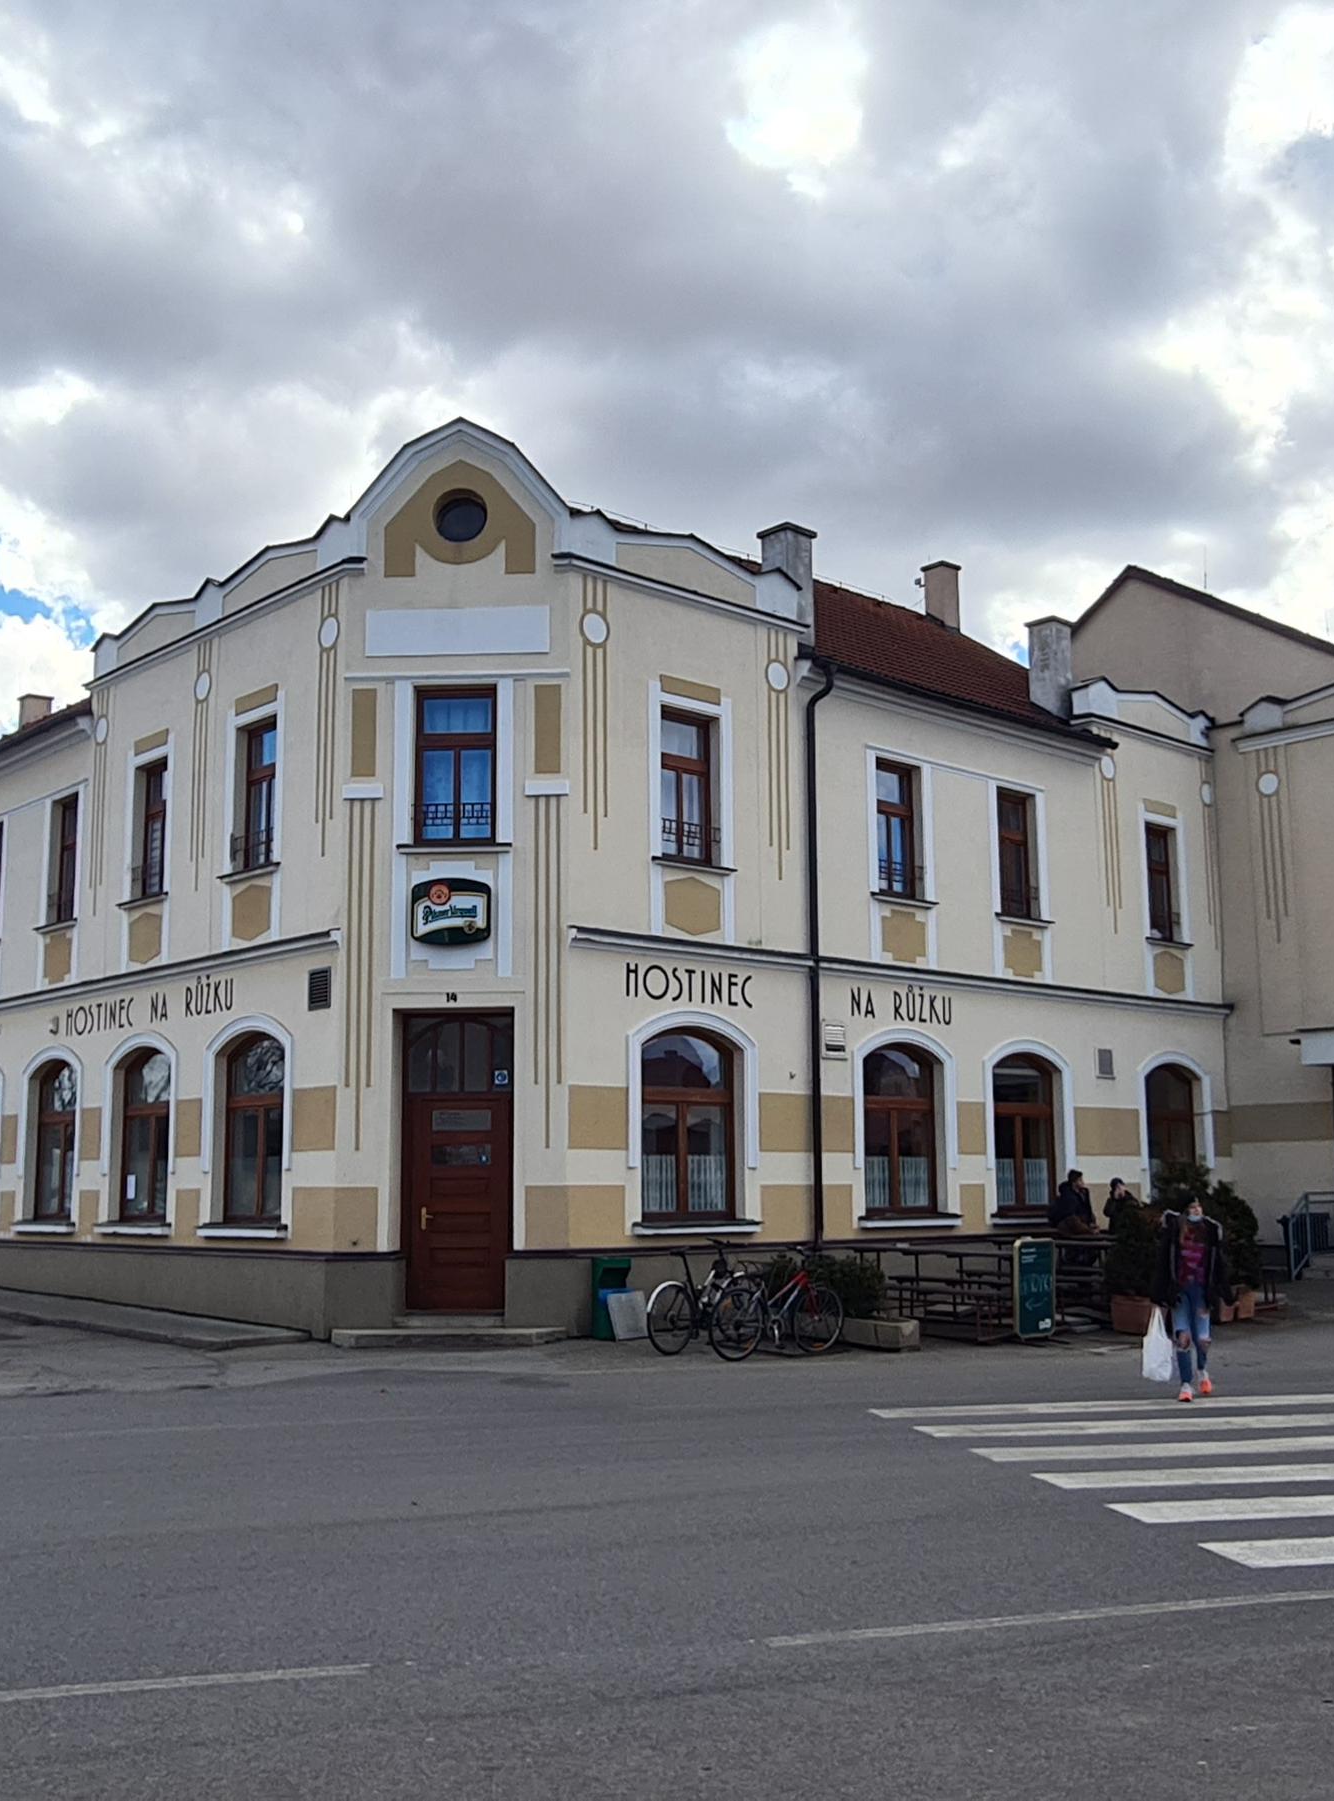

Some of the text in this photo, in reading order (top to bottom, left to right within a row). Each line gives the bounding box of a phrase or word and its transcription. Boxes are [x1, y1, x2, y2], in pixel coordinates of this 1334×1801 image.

[65, 975, 234, 1037] HOSTINEC NA RŮŽKU
[445, 992, 458, 1003] 14
[625, 962, 953, 1026] HOSTINEC NA RŮŽKU
